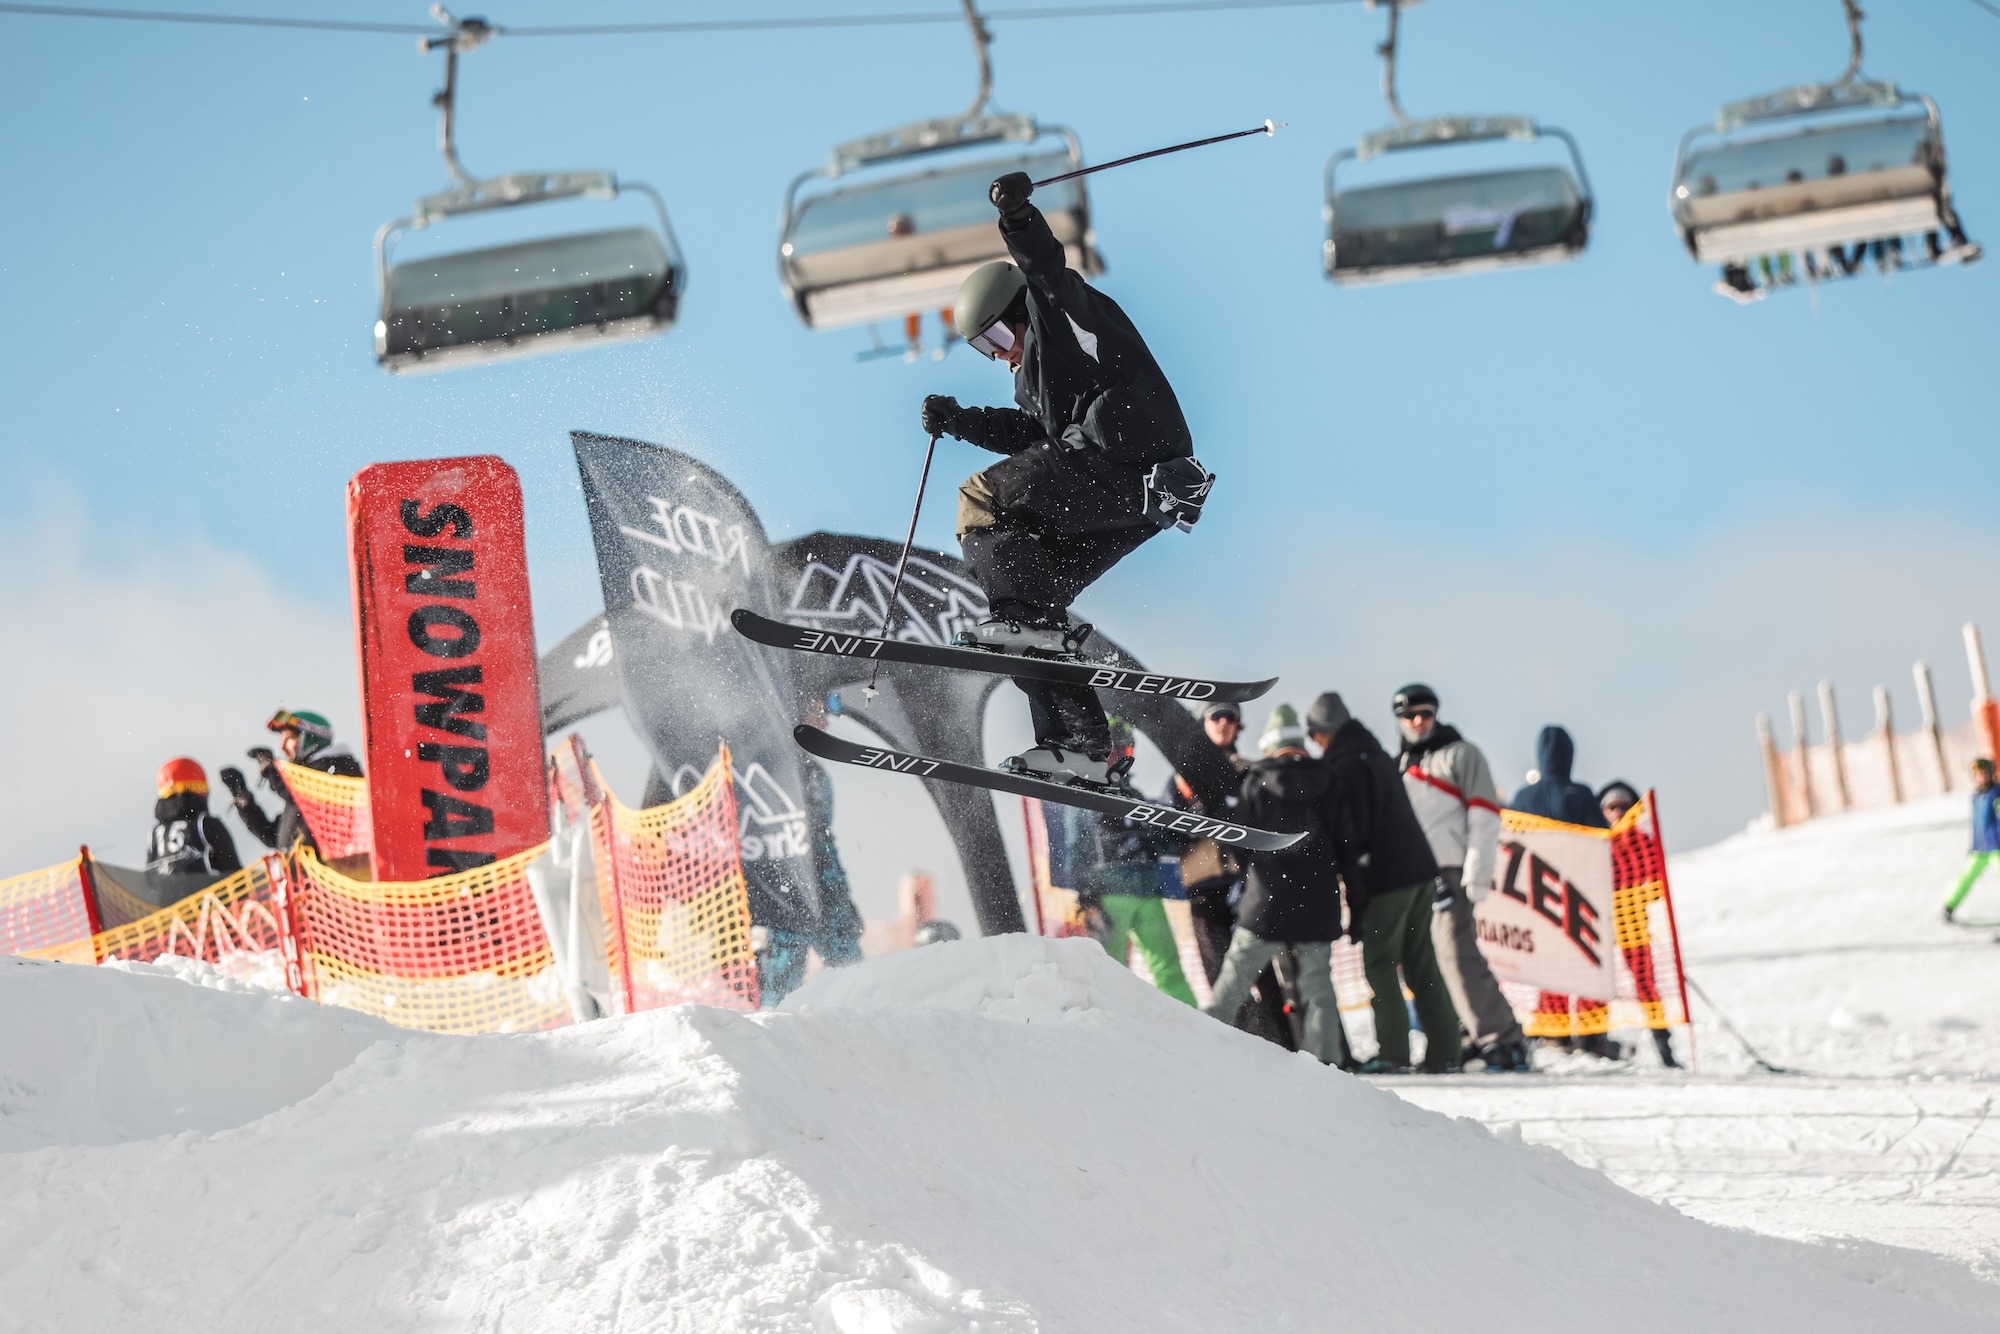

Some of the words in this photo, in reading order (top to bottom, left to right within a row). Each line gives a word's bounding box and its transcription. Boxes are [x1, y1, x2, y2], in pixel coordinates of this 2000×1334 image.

[793, 630, 885, 658] LINE
[851, 748, 940, 776] LINE
[741, 820, 811, 861] Shre
[1491, 838, 1603, 971] ZEE
